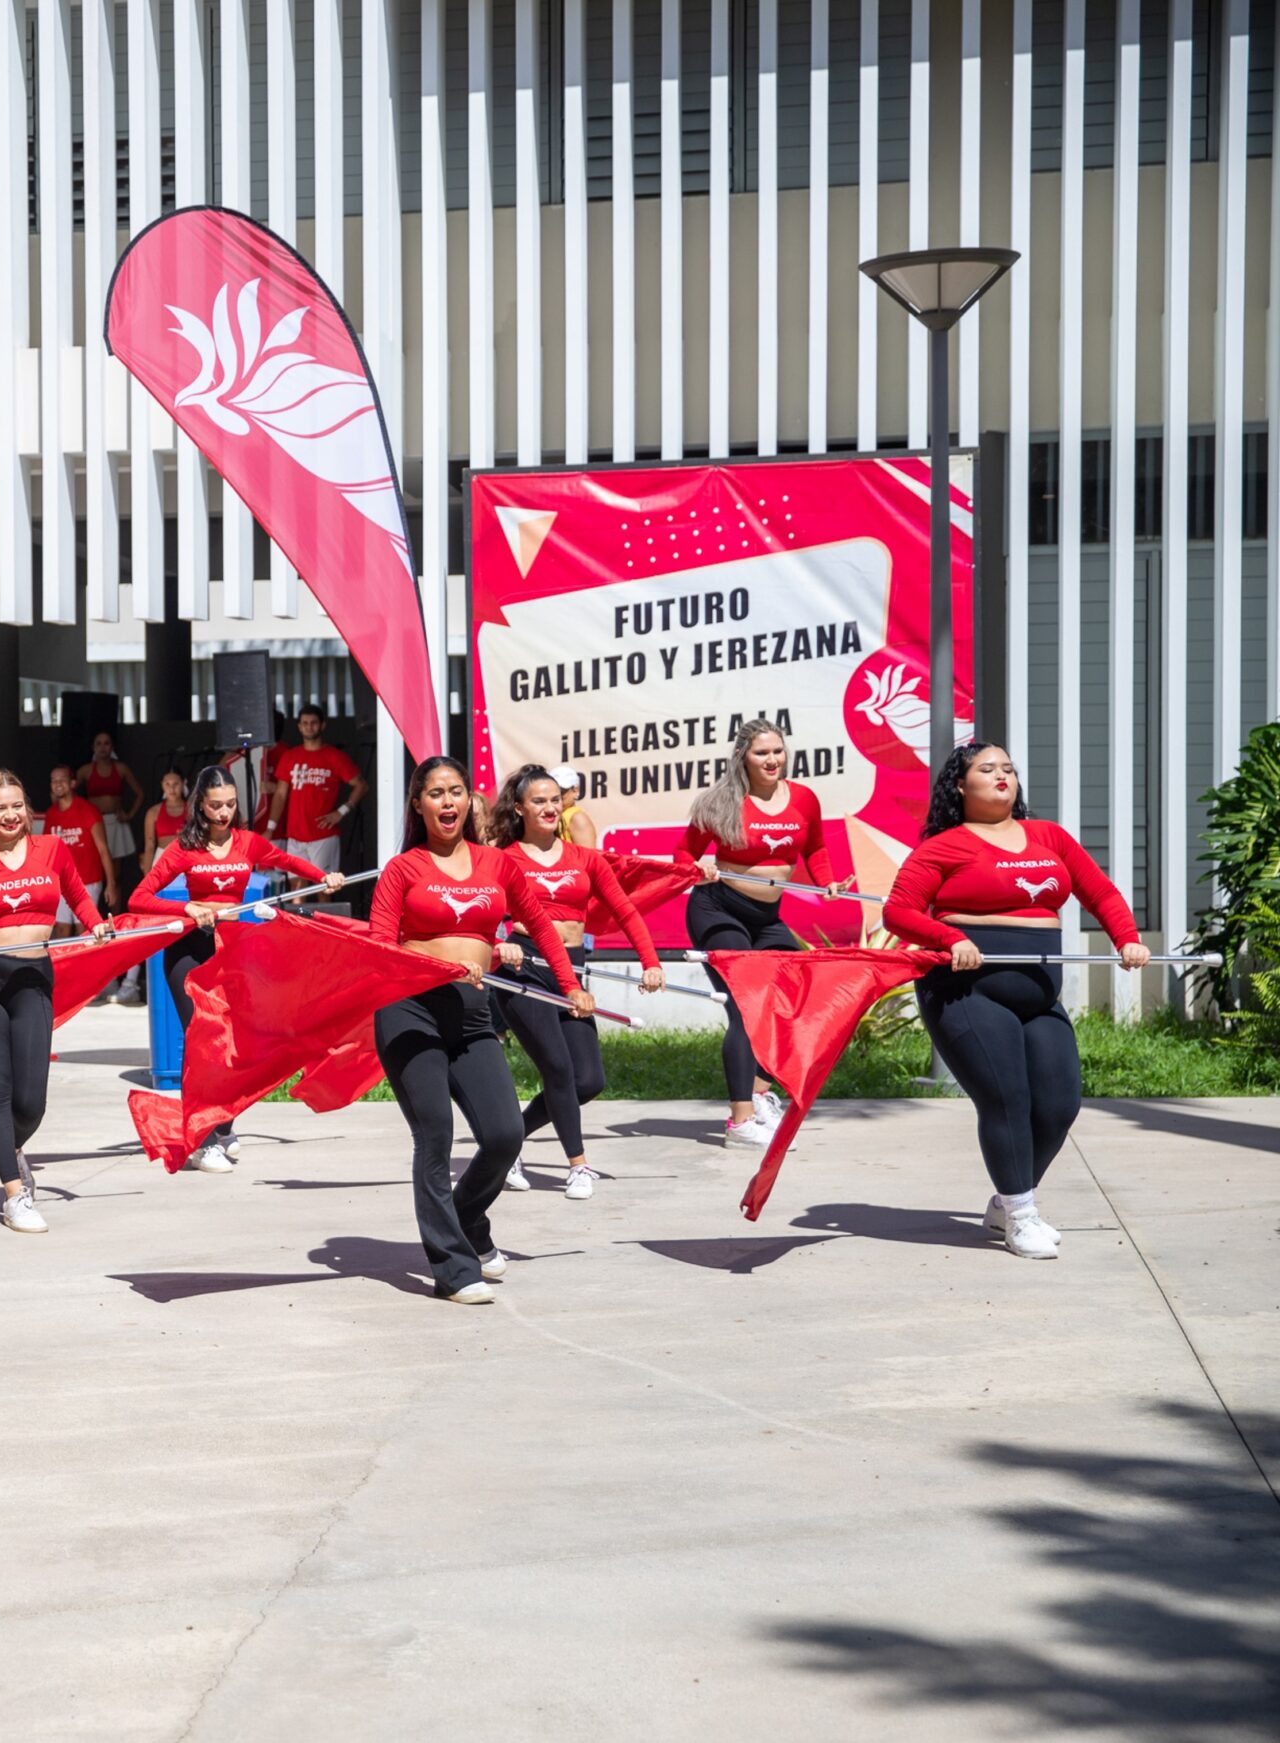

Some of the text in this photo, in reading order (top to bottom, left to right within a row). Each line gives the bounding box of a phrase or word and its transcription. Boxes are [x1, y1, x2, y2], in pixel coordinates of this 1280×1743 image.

[615, 587, 750, 638] FUTURO
[509, 620, 863, 703] GALLITO Y JEREZANA
[560, 708, 793, 764] ¡LLEGASTE A A
[620, 745, 845, 797] UNIVERAD!
[749, 822, 800, 831] ABANDERADA
[190, 863, 250, 873] ABANDERADA
[995, 859, 1058, 869] ABANDERADA
[524, 869, 581, 878] ABANDERADA
[426, 884, 500, 895] ABANDERADA
